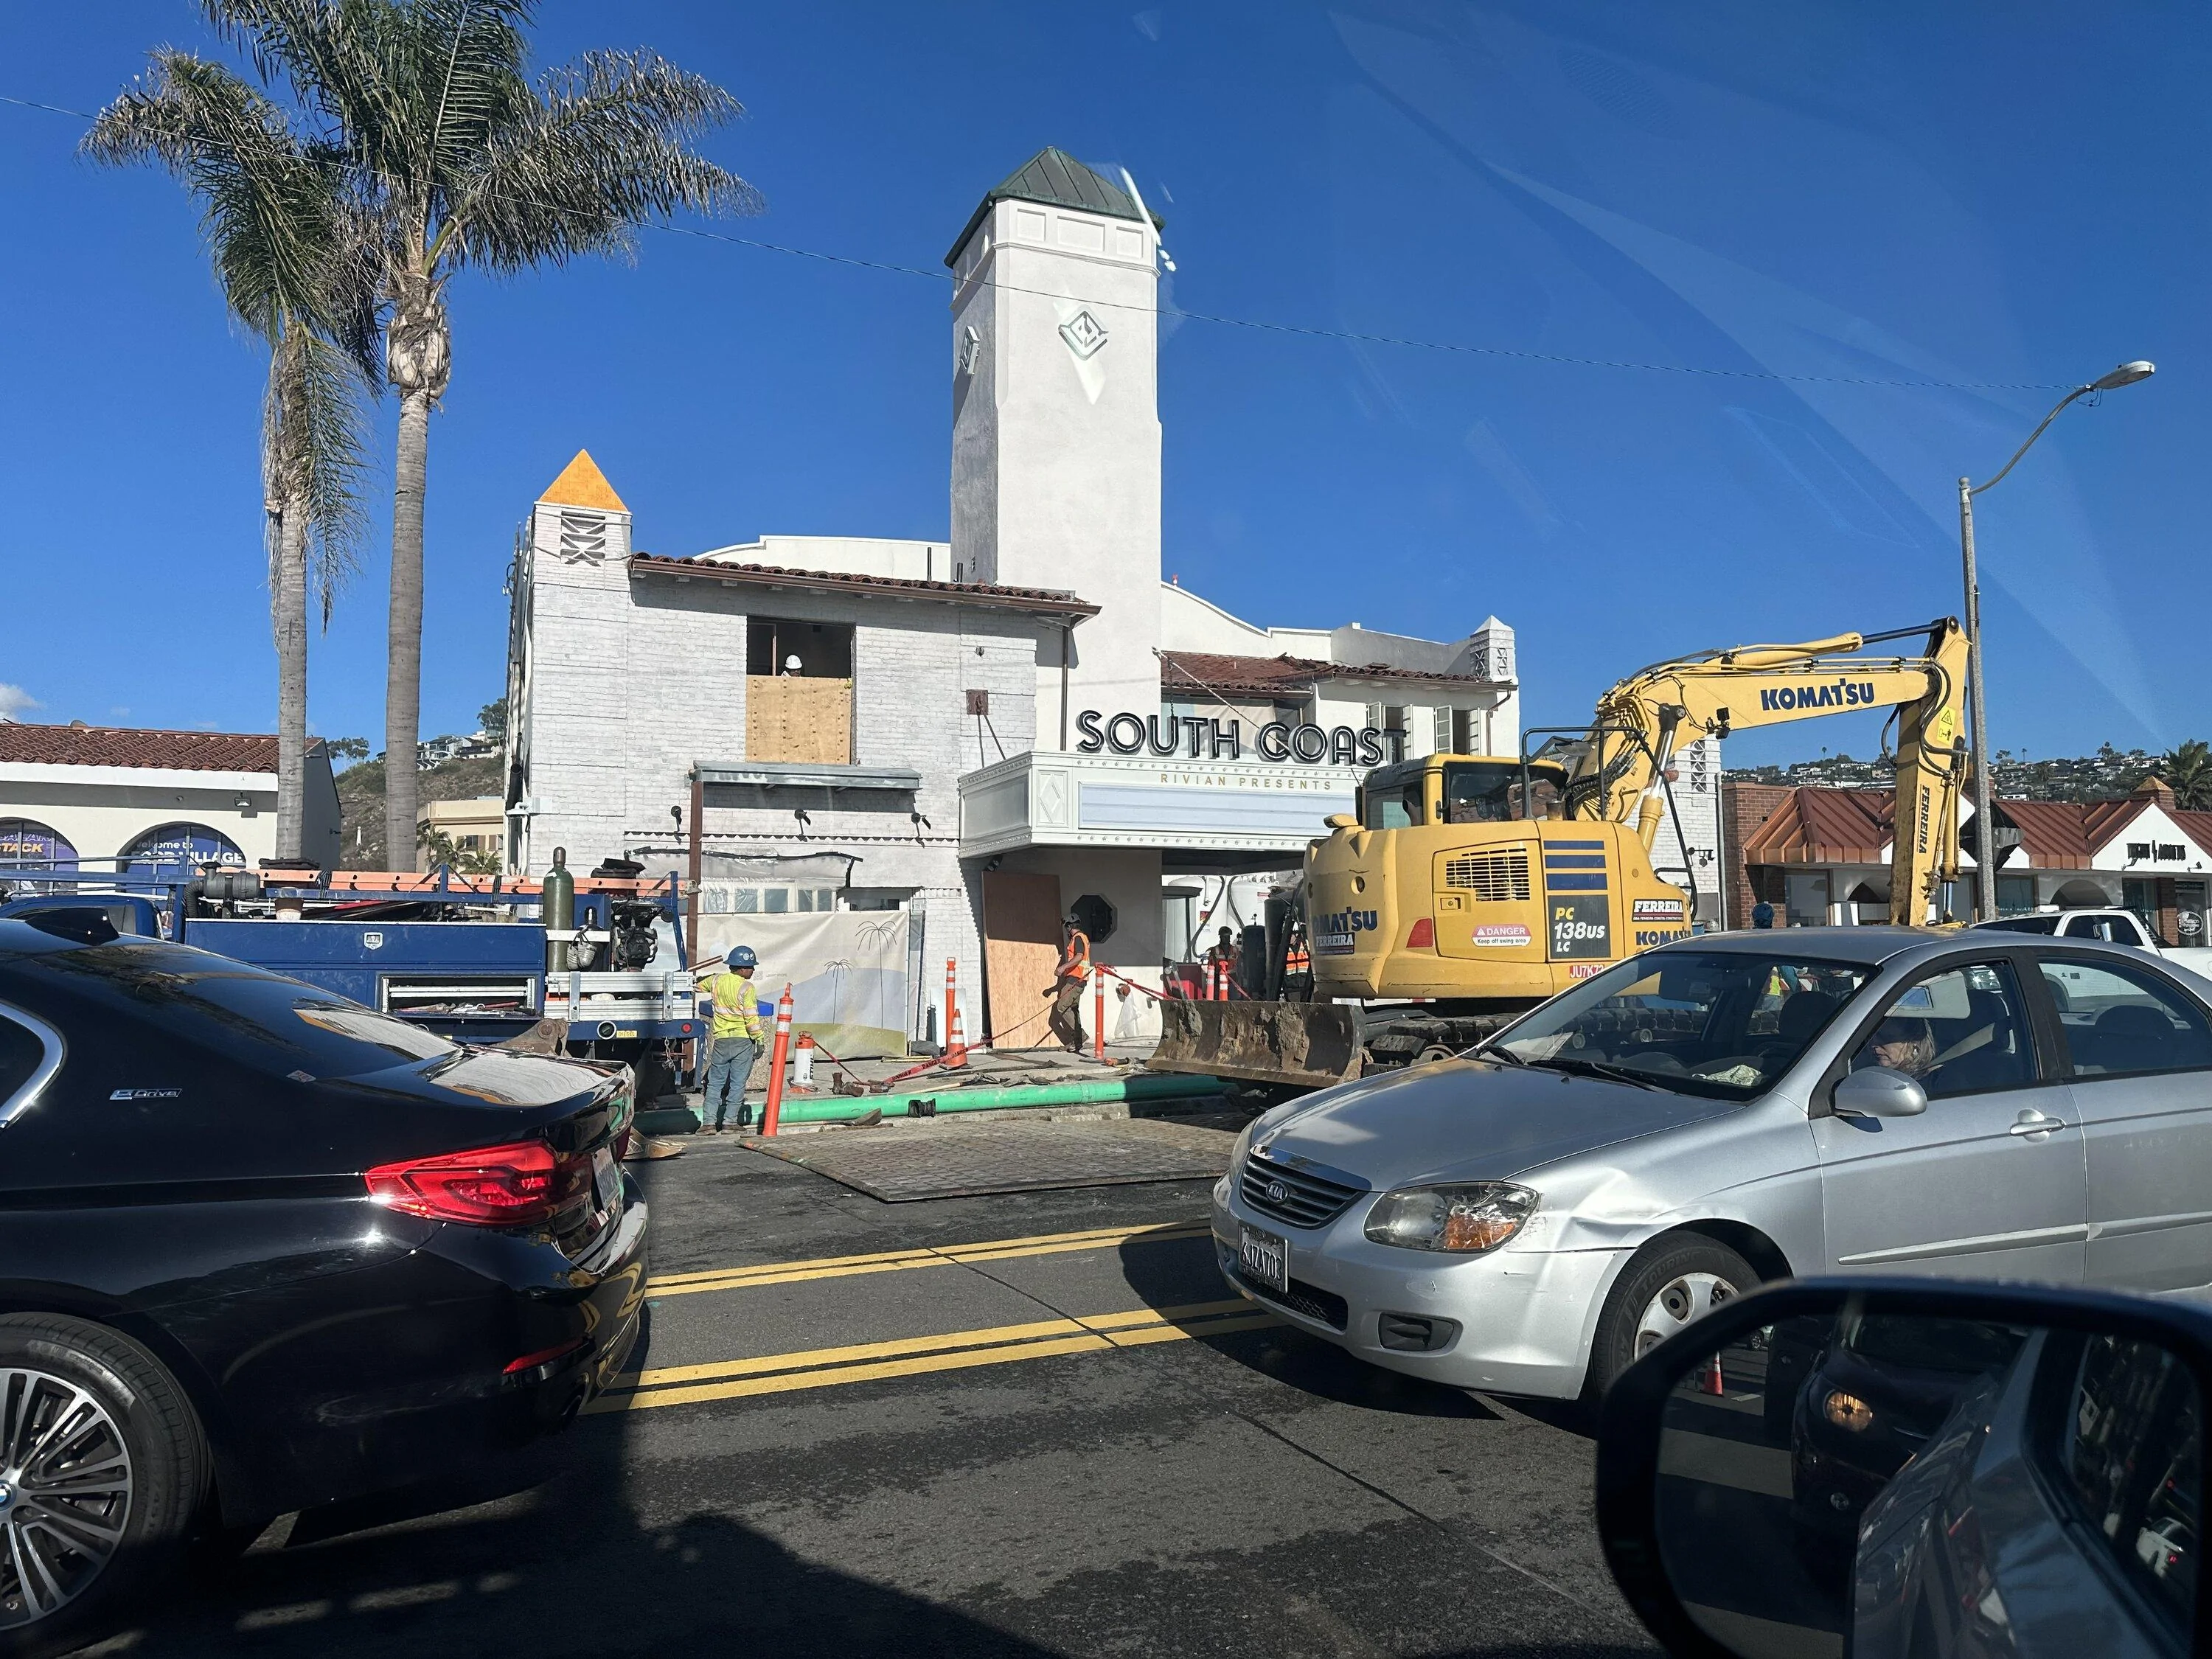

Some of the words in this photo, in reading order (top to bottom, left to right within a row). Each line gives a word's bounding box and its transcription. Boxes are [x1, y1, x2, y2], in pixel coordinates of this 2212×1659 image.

[1760, 678, 1875, 711] KOMATSU
[1076, 709, 1240, 761] SOUTH
[1254, 721, 1407, 767] COAST
[1161, 773, 1226, 786] RIVIAN
[1239, 776, 1331, 790] PRESENTS
[1919, 785, 1930, 853] FERREIRA
[0, 843, 44, 852] TACK
[1555, 907, 1575, 920] PC
[1633, 900, 1683, 913] FERREIRA
[1486, 927, 1526, 936] DANGER
[1315, 933, 1354, 947] FERREIRA
[1556, 941, 1571, 953] LC
[1268, 1184, 1284, 1200] KIA
[1242, 1241, 1282, 1281] 6JZA703
